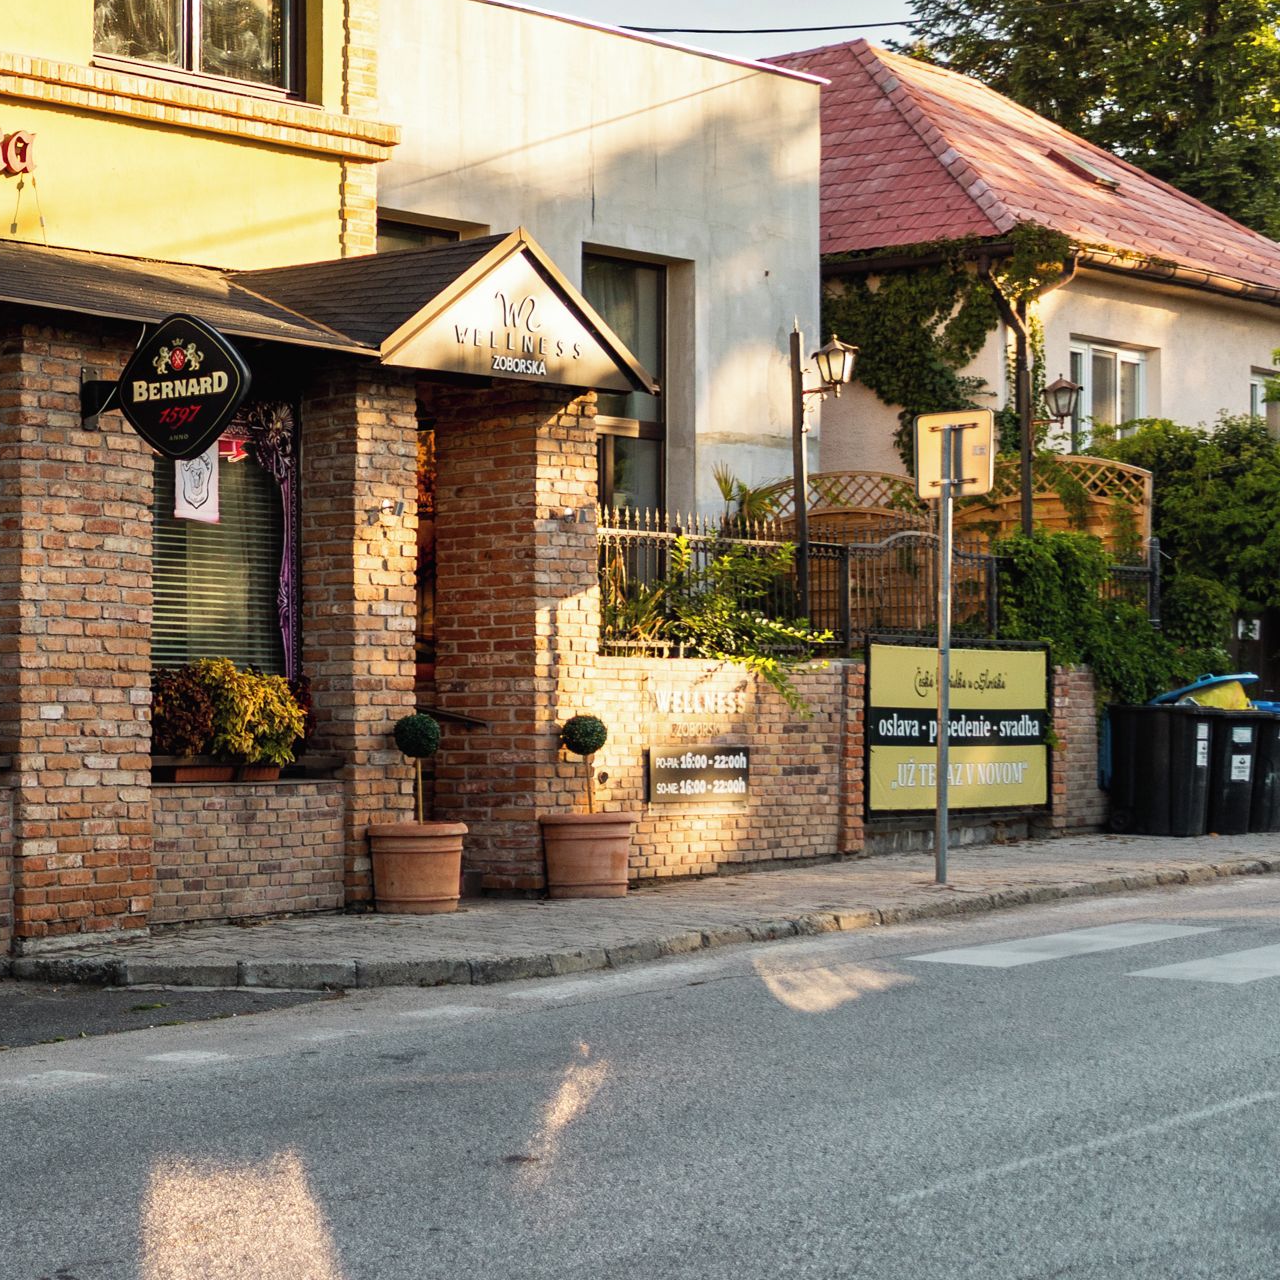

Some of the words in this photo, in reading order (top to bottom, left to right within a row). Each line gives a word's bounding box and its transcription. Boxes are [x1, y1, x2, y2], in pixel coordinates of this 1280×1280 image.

[455, 324, 580, 359] WELLNESS
[493, 355, 547, 375] ZOBORSKÁ
[132, 371, 228, 402] BERNARD
[159, 405, 202, 430] 1597
[655, 690, 746, 713] WELLNESS
[878, 713, 920, 737] oslava
[929, 714, 991, 743] psedenie
[999, 714, 1040, 737] svadba
[680, 752, 707, 768] 16:00
[713, 751, 747, 769] 22:00h
[680, 779, 706, 795] 16:00
[712, 776, 746, 793] 22:00h
[919, 762, 963, 786] TEAZ
[966, 762, 975, 785] V
